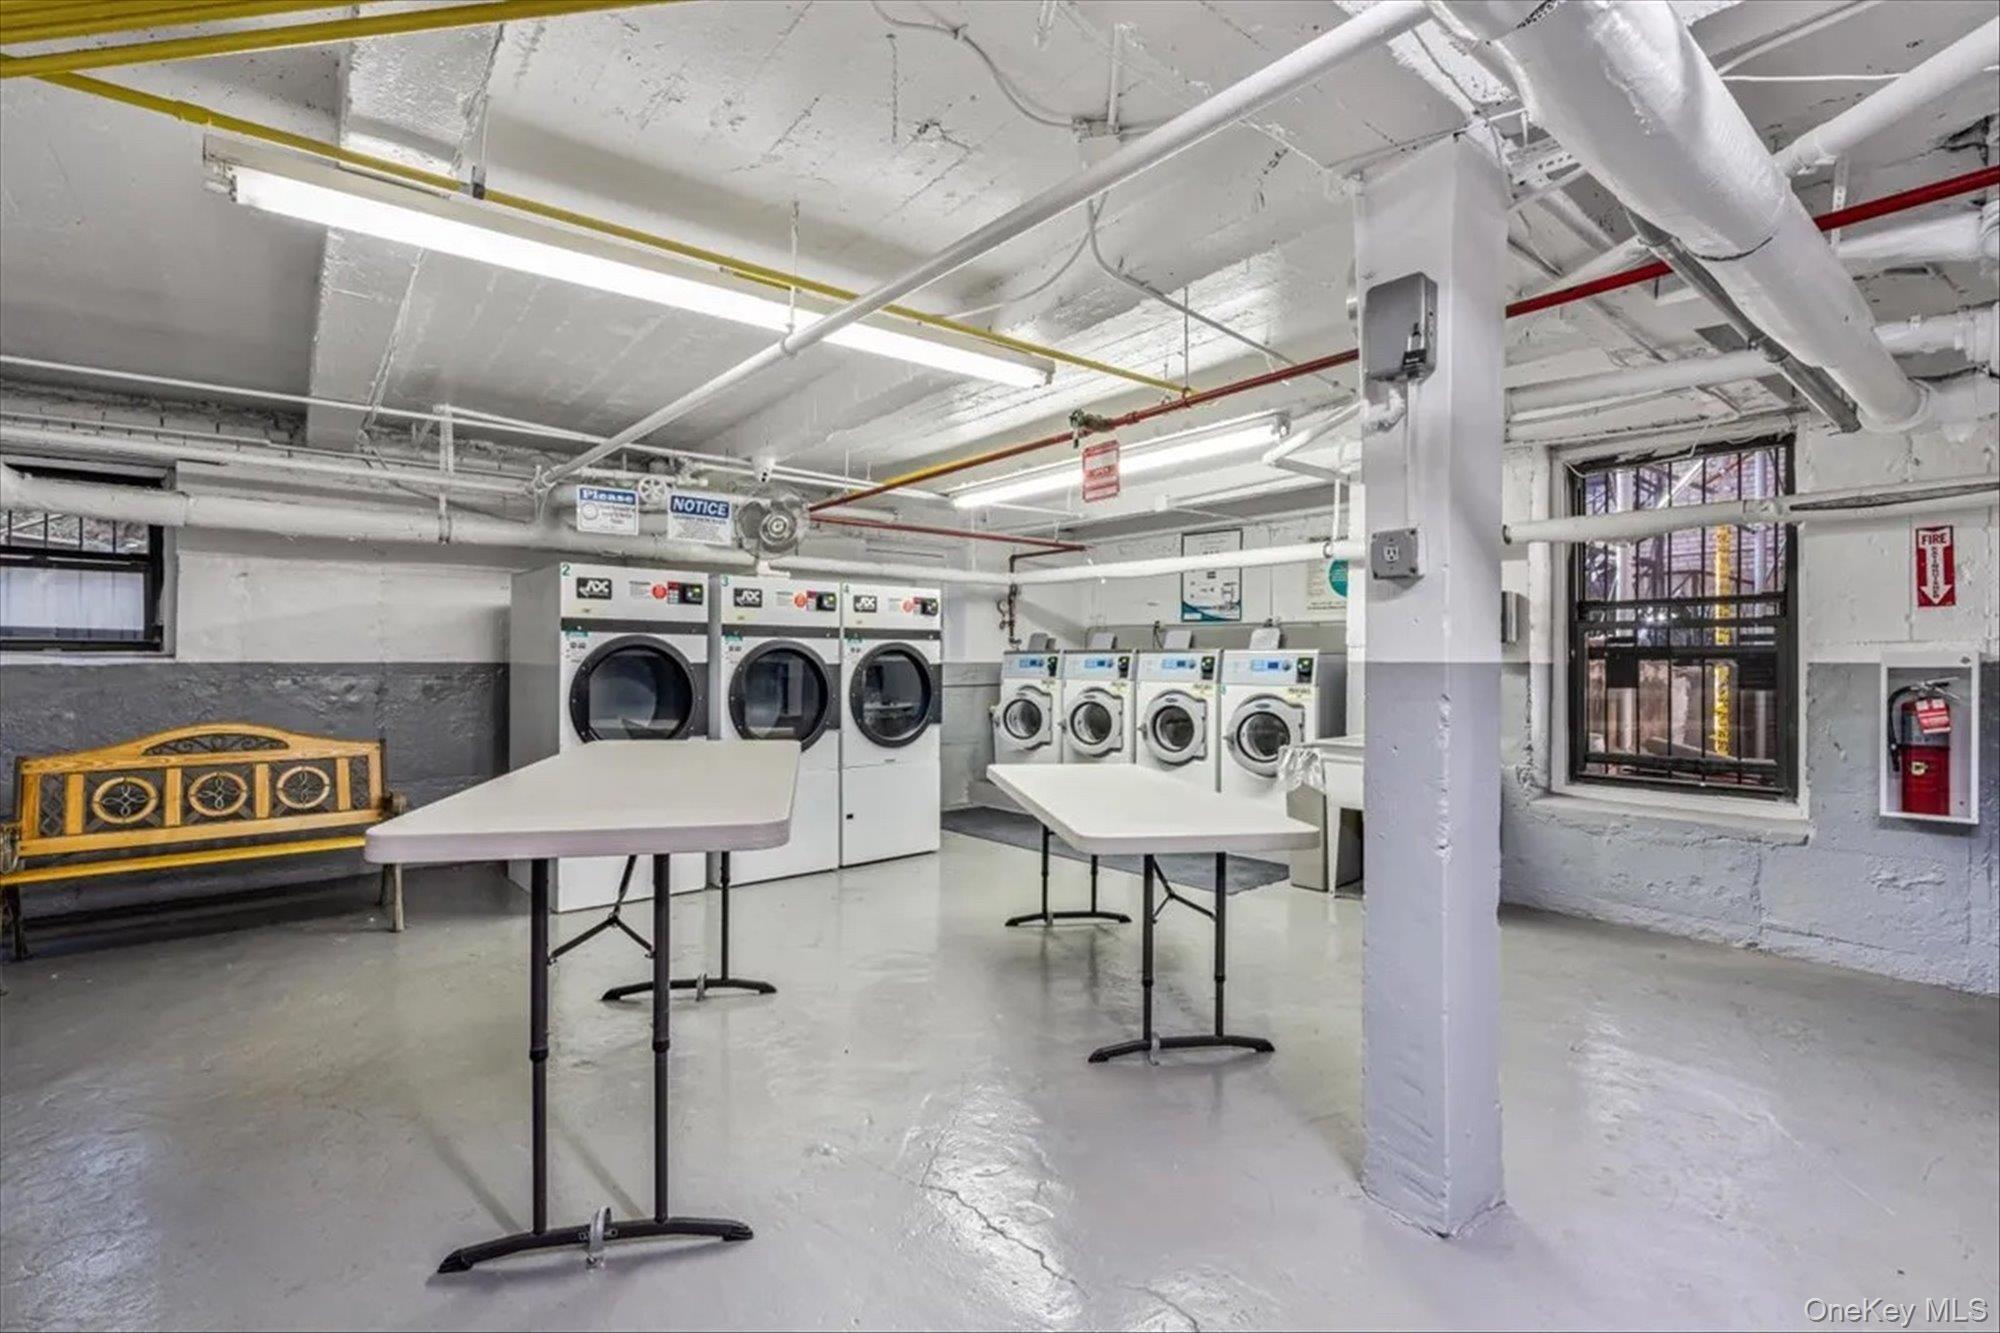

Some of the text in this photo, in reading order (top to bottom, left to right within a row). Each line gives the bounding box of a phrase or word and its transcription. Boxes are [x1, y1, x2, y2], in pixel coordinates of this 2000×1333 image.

[582, 489, 634, 503] Please
[673, 497, 727, 517] NOTICE
[1921, 533, 1947, 545] FIRE
[562, 563, 571, 576] 2
